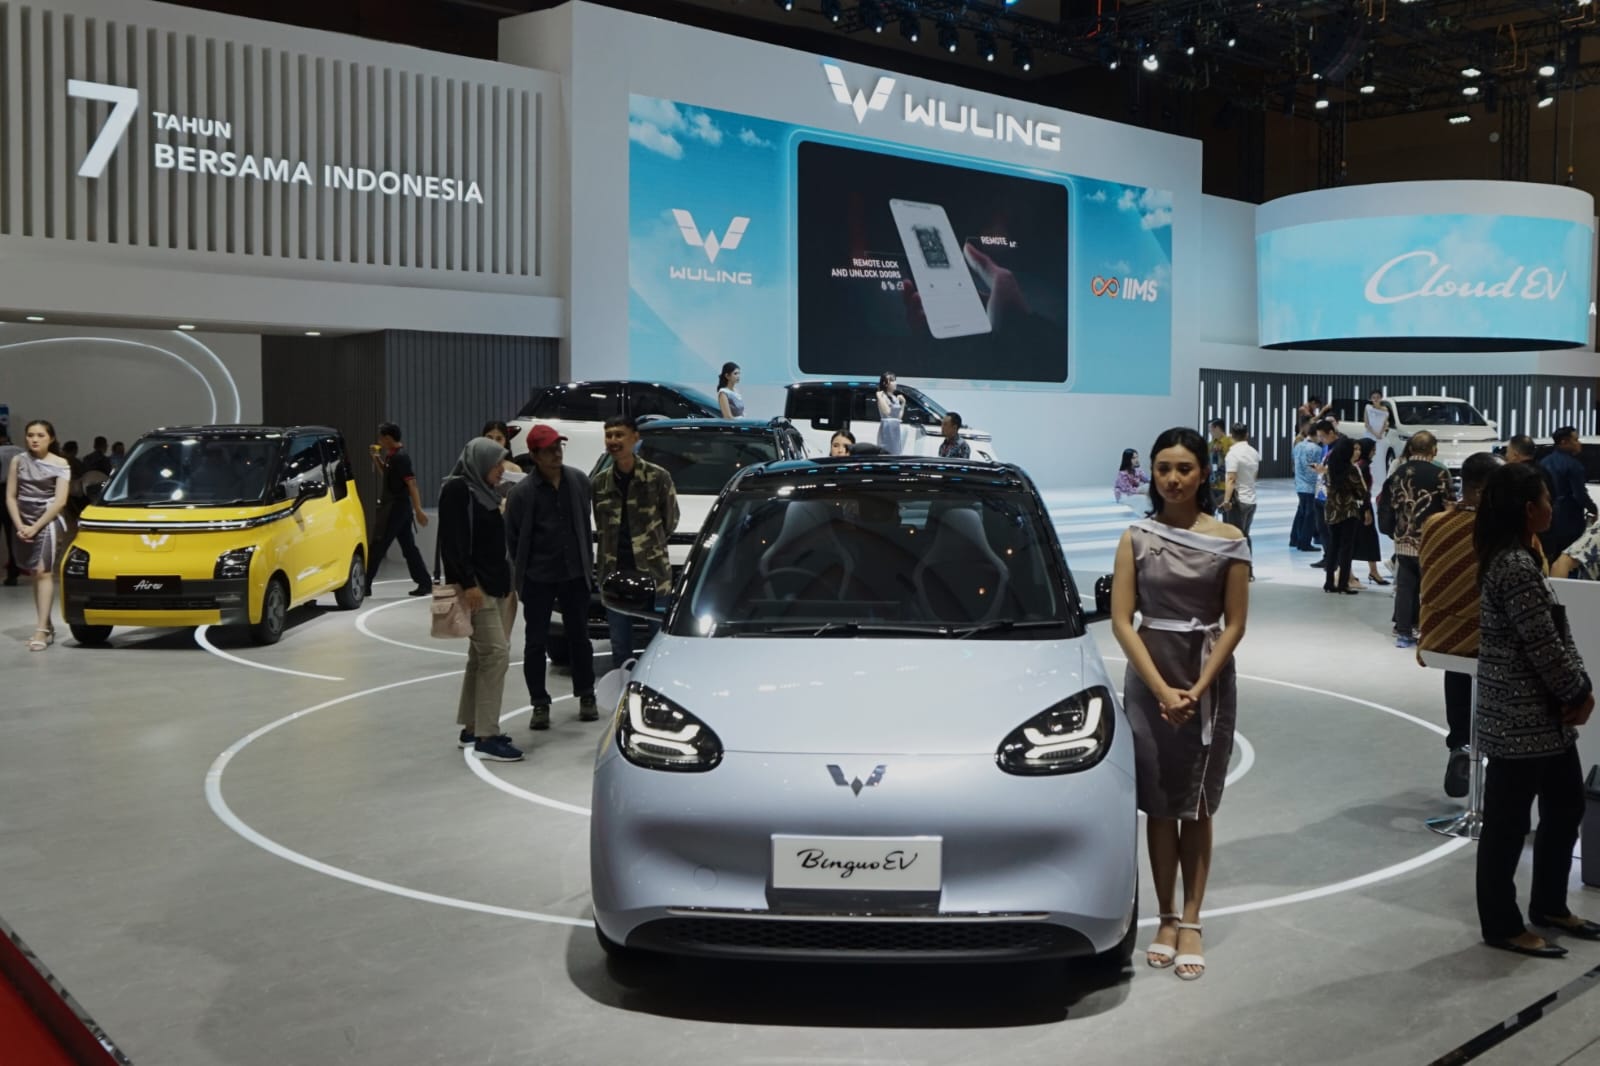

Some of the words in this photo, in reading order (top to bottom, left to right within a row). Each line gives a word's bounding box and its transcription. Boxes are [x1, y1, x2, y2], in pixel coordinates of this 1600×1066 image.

[67, 79, 138, 178] 7
[153, 111, 232, 139] TAHUN
[904, 93, 1061, 152] WULING
[154, 143, 313, 186] BERSAMA
[324, 164, 484, 204] INDONESIA
[980, 235, 1008, 246] REMOTE
[669, 265, 752, 285] WULING
[831, 268, 848, 278] AND
[848, 268, 879, 278] UNLOCK
[879, 270, 902, 279] DOORS
[852, 258, 881, 268] REMOTE
[881, 260, 899, 269] LOCK
[1365, 250, 1526, 304] Cloud
[1520, 266, 1567, 300] EV
[1122, 277, 1158, 302] IIMS
[797, 848, 880, 878] Binguo
[882, 850, 918, 870] EV
